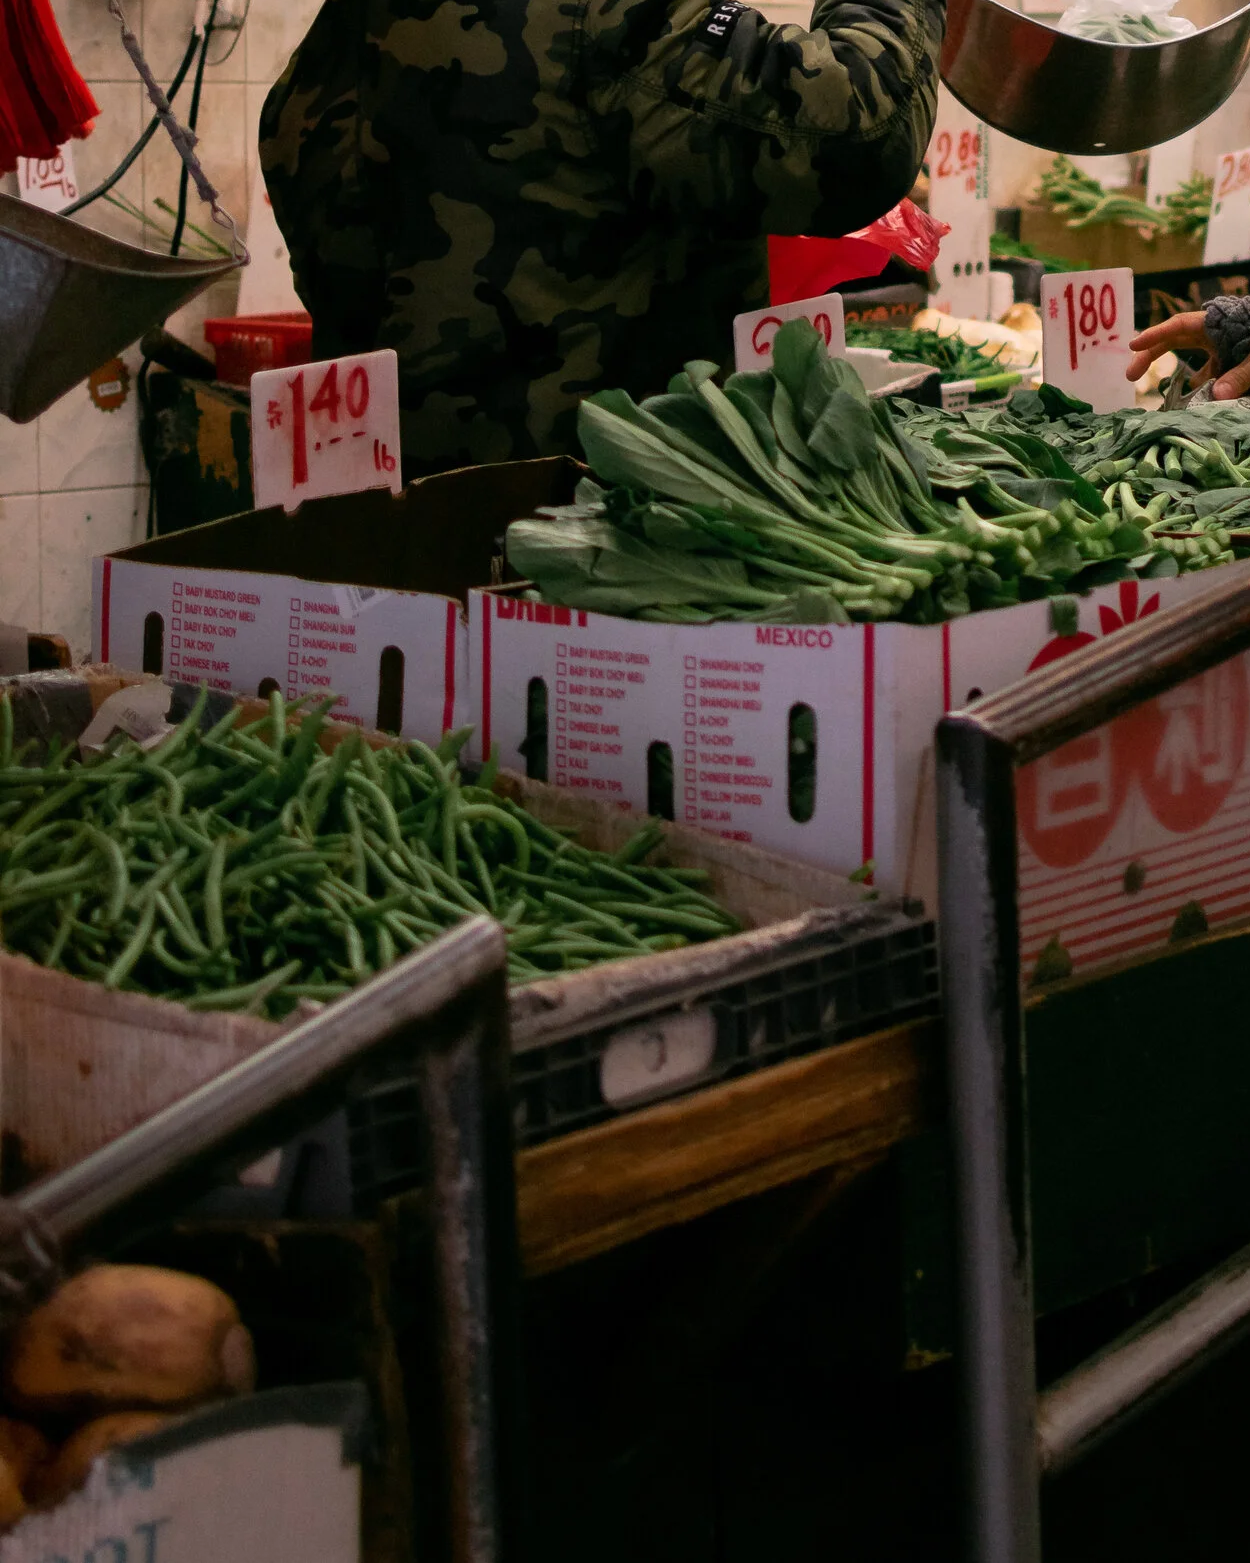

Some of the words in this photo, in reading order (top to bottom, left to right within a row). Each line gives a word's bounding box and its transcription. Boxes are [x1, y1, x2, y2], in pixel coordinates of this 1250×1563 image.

[374, 439, 396, 472] lb
[185, 585, 203, 597] BABY
[203, 587, 236, 603] MUSTARD
[237, 592, 261, 605] GREEN
[184, 603, 202, 615] BABY
[203, 606, 218, 617] BOK
[219, 608, 237, 620] CHOY
[183, 621, 201, 632] BABY
[202, 623, 218, 634] BOK
[218, 626, 237, 638] CHOY
[303, 619, 338, 632] SHANGHAI
[339, 624, 356, 635] SUM
[302, 637, 337, 651] SHANGHAI
[756, 626, 834, 649] MEXICO
[183, 638, 196, 649] TAK
[197, 641, 215, 653] CHOY
[569, 645, 588, 658] BABY
[182, 656, 210, 669] CHINESE
[212, 659, 230, 672] RAPE
[301, 655, 328, 667] A-CHOY
[569, 663, 588, 676] BABY
[568, 683, 588, 696] BABY
[568, 756, 588, 769] KALE
